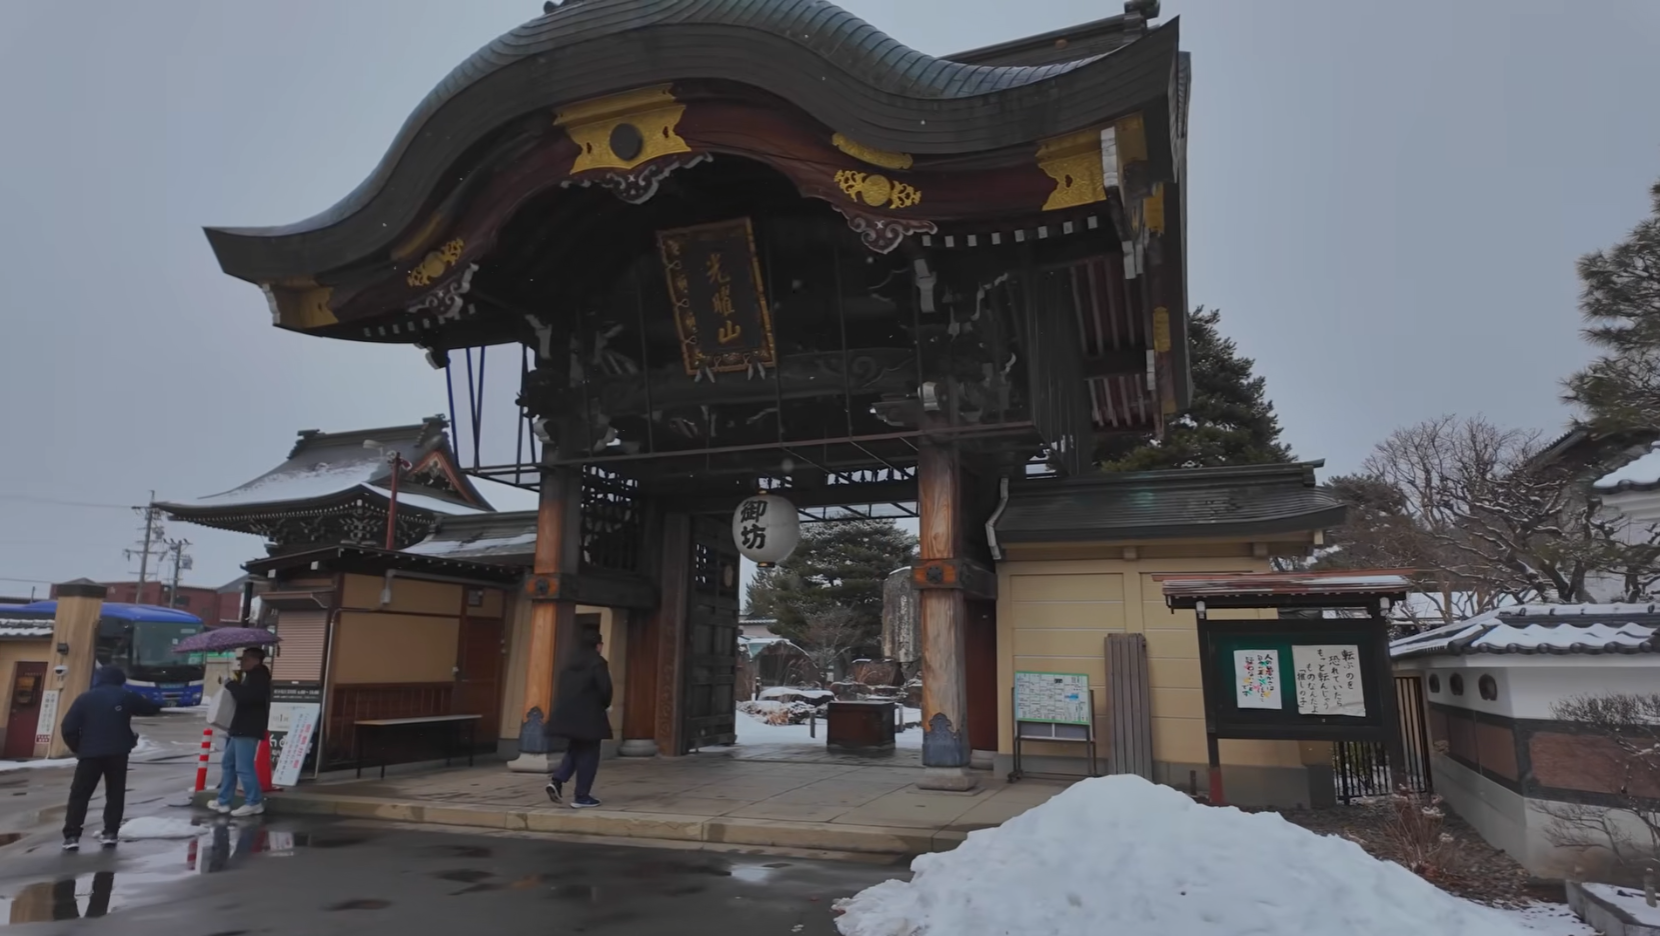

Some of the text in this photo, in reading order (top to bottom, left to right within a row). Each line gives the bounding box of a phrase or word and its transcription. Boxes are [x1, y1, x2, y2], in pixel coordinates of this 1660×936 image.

[740, 500, 768, 550] 御坊
[1327, 655, 1343, 707] 恐れていたら
[1341, 649, 1355, 690] 転ぶのを
